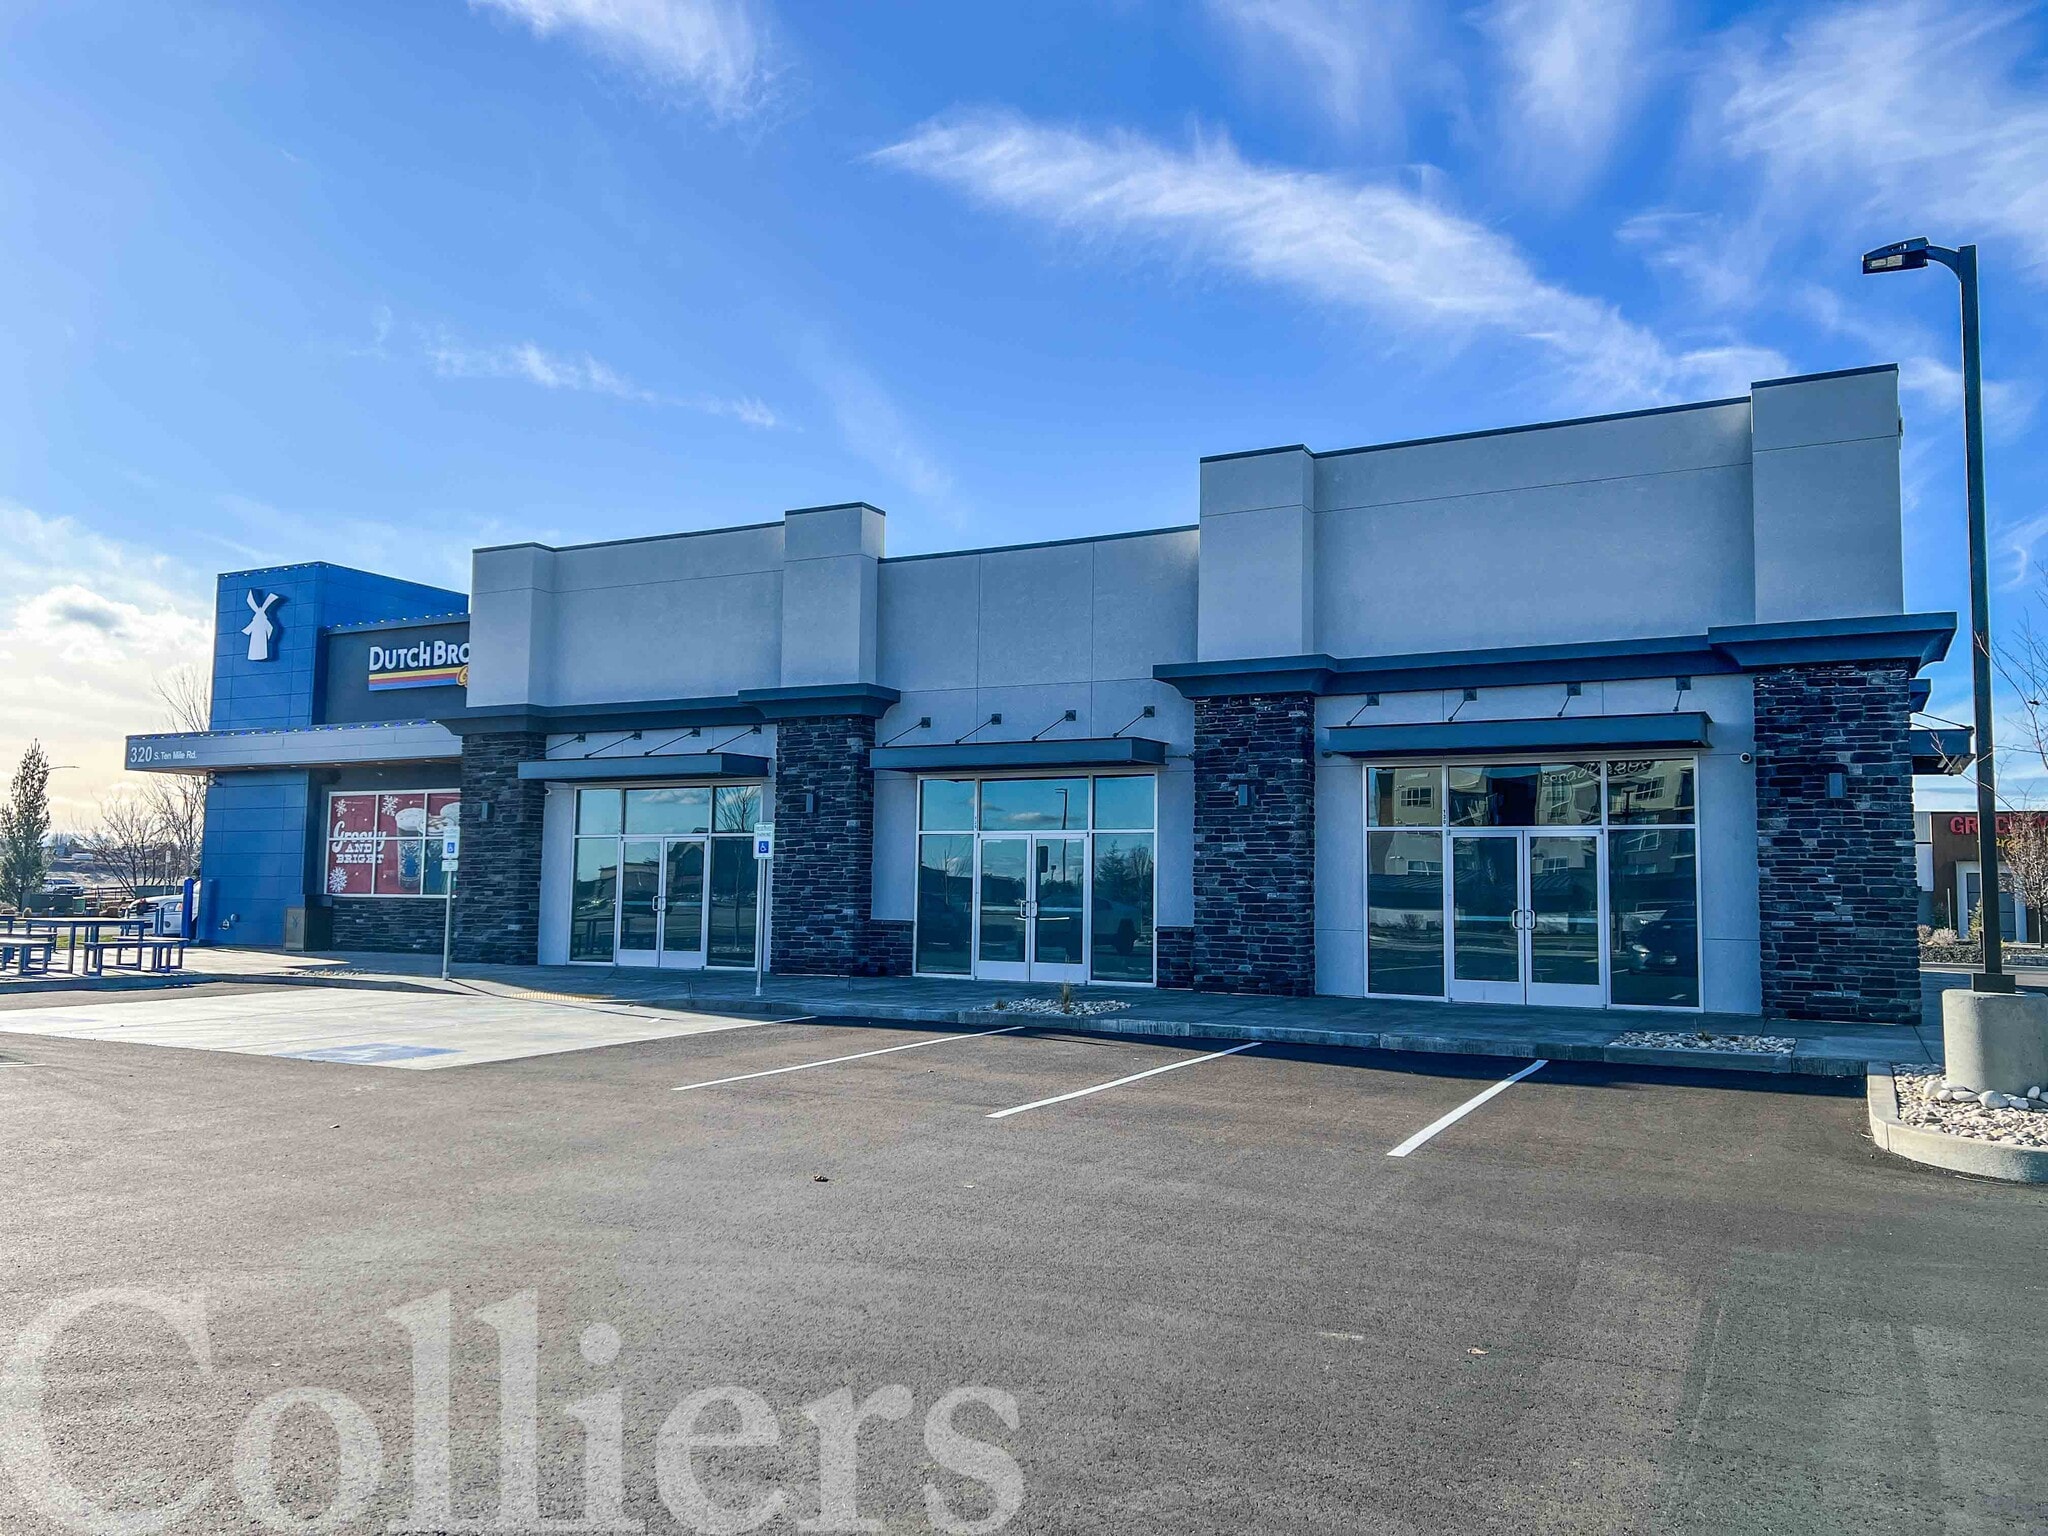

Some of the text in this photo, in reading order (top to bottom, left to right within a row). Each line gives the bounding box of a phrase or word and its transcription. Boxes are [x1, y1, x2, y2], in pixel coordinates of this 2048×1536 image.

[130, 746, 198, 763] 320 S. Ten Mile Rd.
[345, 843, 373, 853] AND
[336, 853, 385, 864] BRIGHT
